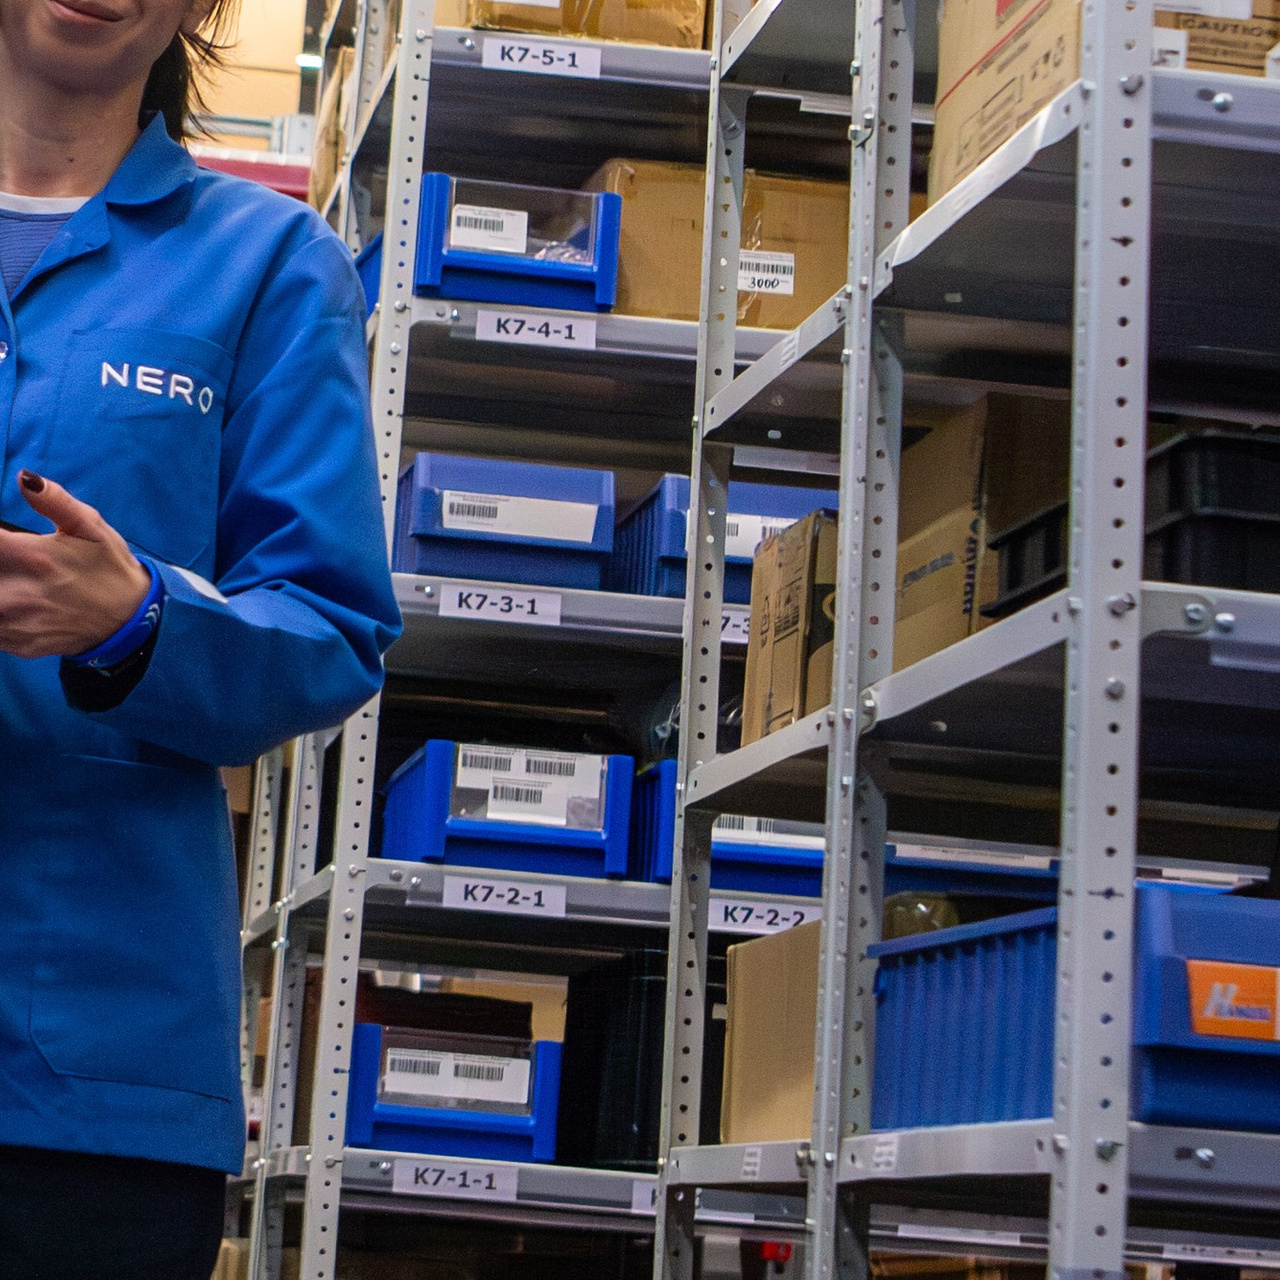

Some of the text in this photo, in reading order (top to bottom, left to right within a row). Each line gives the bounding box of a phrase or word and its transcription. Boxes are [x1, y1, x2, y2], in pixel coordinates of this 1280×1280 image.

[500, 45, 578, 68] K7-5-1
[748, 276, 780, 289] 3000
[496, 317, 575, 340] K7-4-1
[101, 361, 214, 415] NERO
[458, 591, 538, 615] K7-3-1
[463, 883, 545, 907] K7-2-1
[723, 905, 805, 927] K7-2-2
[414, 1167, 497, 1190] K7-1-1
